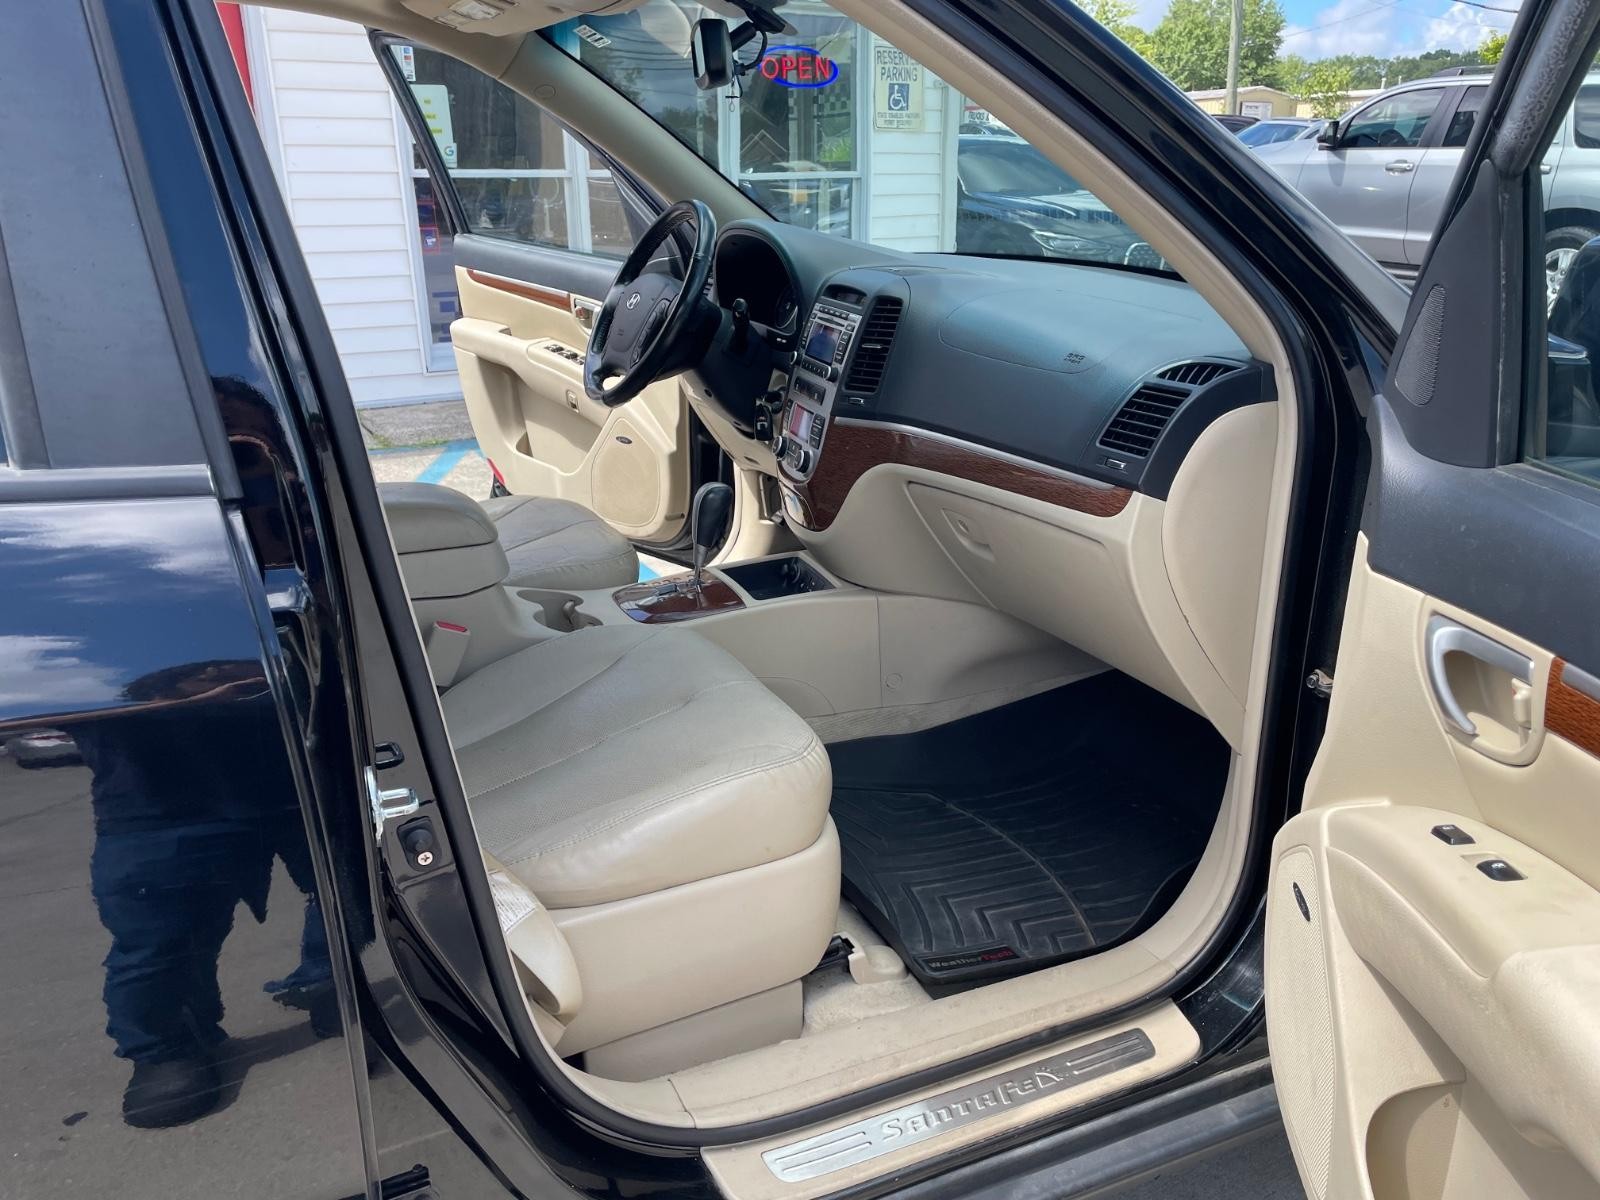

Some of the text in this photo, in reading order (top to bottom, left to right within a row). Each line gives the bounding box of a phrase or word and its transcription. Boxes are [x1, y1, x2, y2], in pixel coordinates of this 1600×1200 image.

[876, 50, 921, 65] RESERV
[762, 56, 830, 79] OPEN
[880, 66, 917, 82] PARKING
